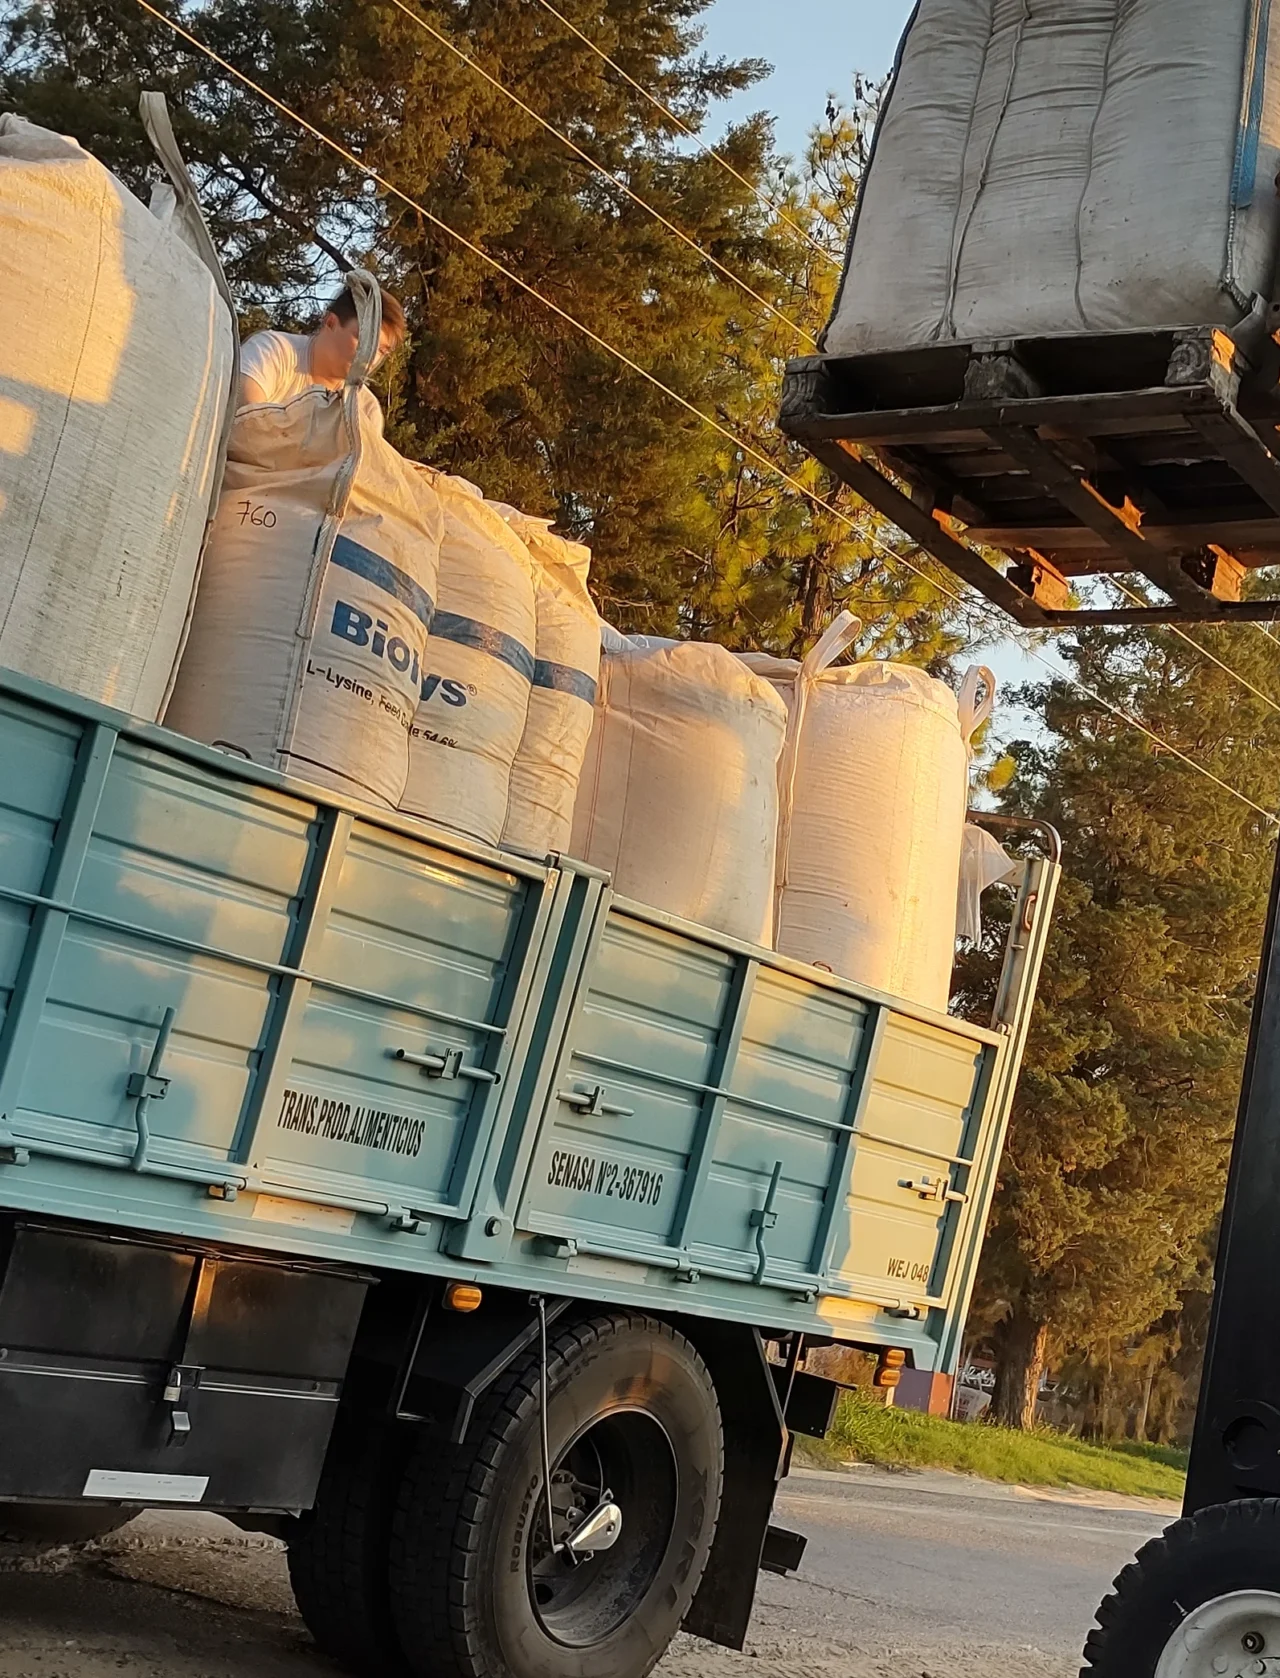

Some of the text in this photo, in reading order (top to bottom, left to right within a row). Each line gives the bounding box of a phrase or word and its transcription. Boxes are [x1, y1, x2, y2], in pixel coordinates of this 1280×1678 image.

[236, 500, 277, 528] 760
[547, 1150, 596, 1193] SENASA
[887, 1257, 930, 1283] WEJ 048
[510, 1474, 539, 1573] ROBUSTO
